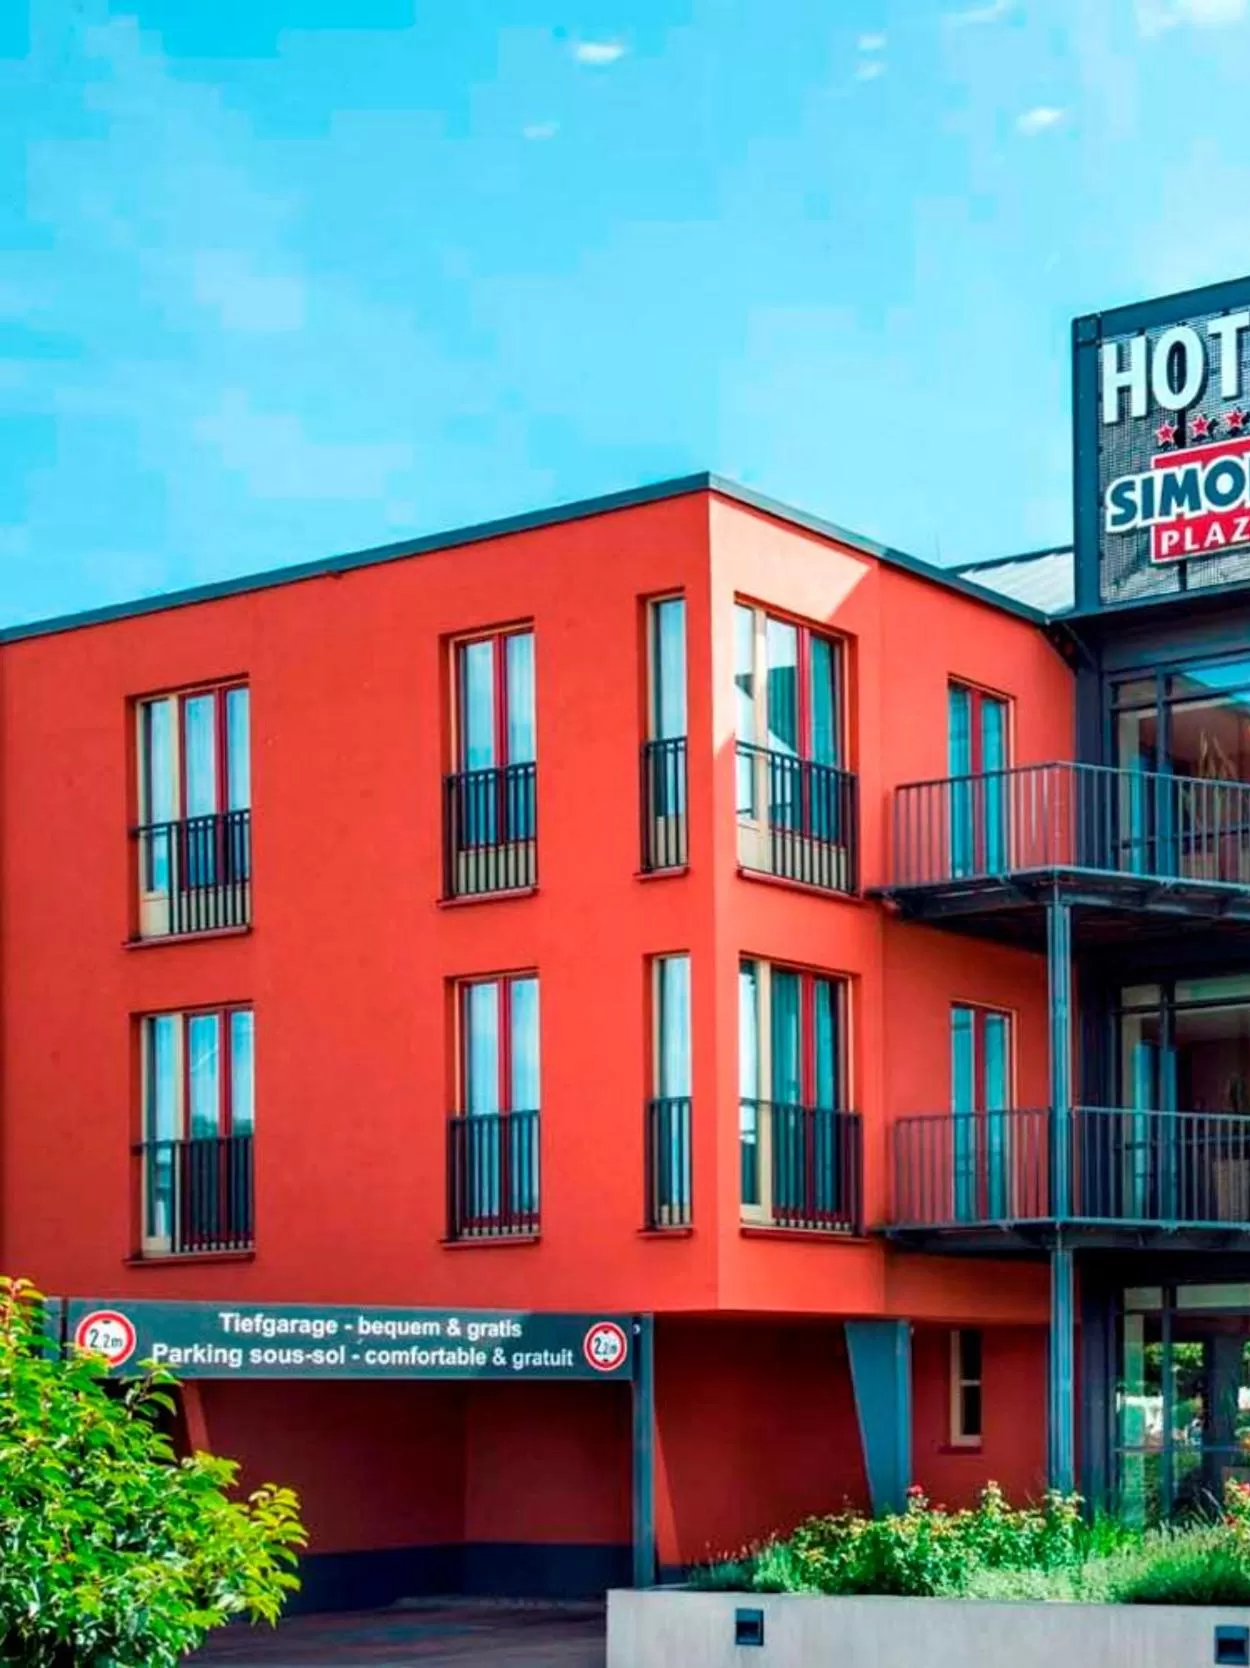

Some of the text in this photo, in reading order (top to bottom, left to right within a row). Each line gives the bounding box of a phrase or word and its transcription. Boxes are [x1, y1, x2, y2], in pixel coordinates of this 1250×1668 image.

[219, 1313, 338, 1338] Tiefgarage
[358, 1316, 440, 1339] bequem
[447, 1318, 461, 1337] &
[467, 1319, 522, 1340] gratis
[152, 1343, 242, 1367] Parking
[250, 1345, 345, 1364] sous-sol
[365, 1346, 486, 1366] comfortable
[492, 1348, 507, 1366] &
[512, 1349, 574, 1370] gratuit
